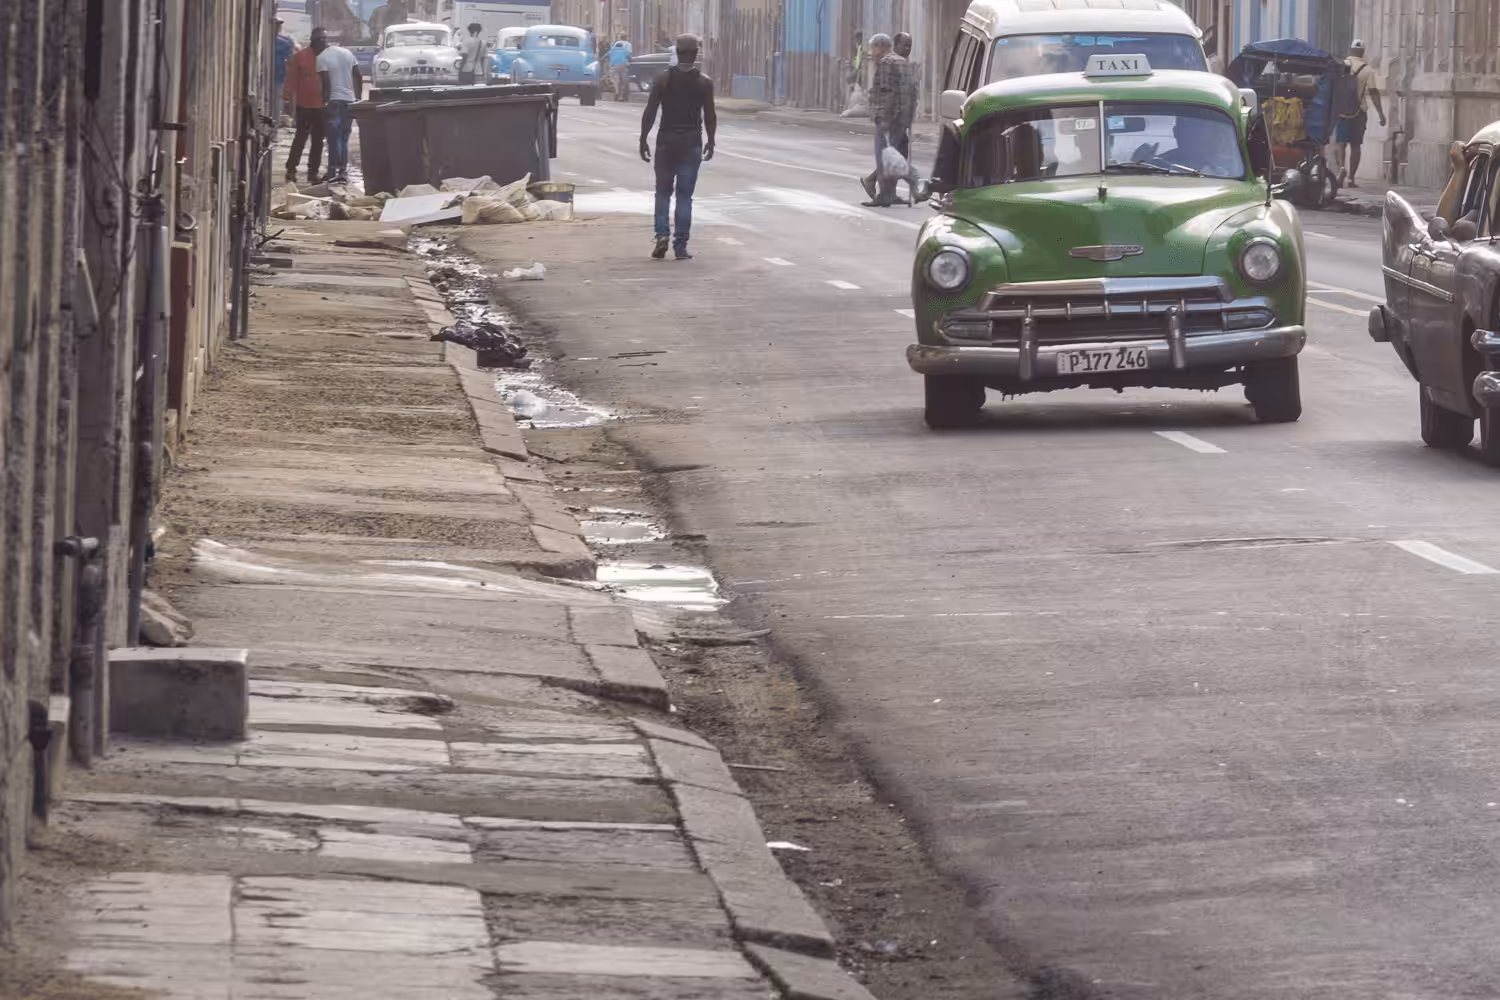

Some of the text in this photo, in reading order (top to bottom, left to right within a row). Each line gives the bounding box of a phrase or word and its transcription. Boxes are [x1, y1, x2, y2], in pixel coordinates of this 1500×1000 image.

[1096, 60, 1138, 70] TAXI
[1070, 355, 1079, 372] P
[1083, 353, 1112, 370] 177
[1116, 350, 1146, 369] 246
